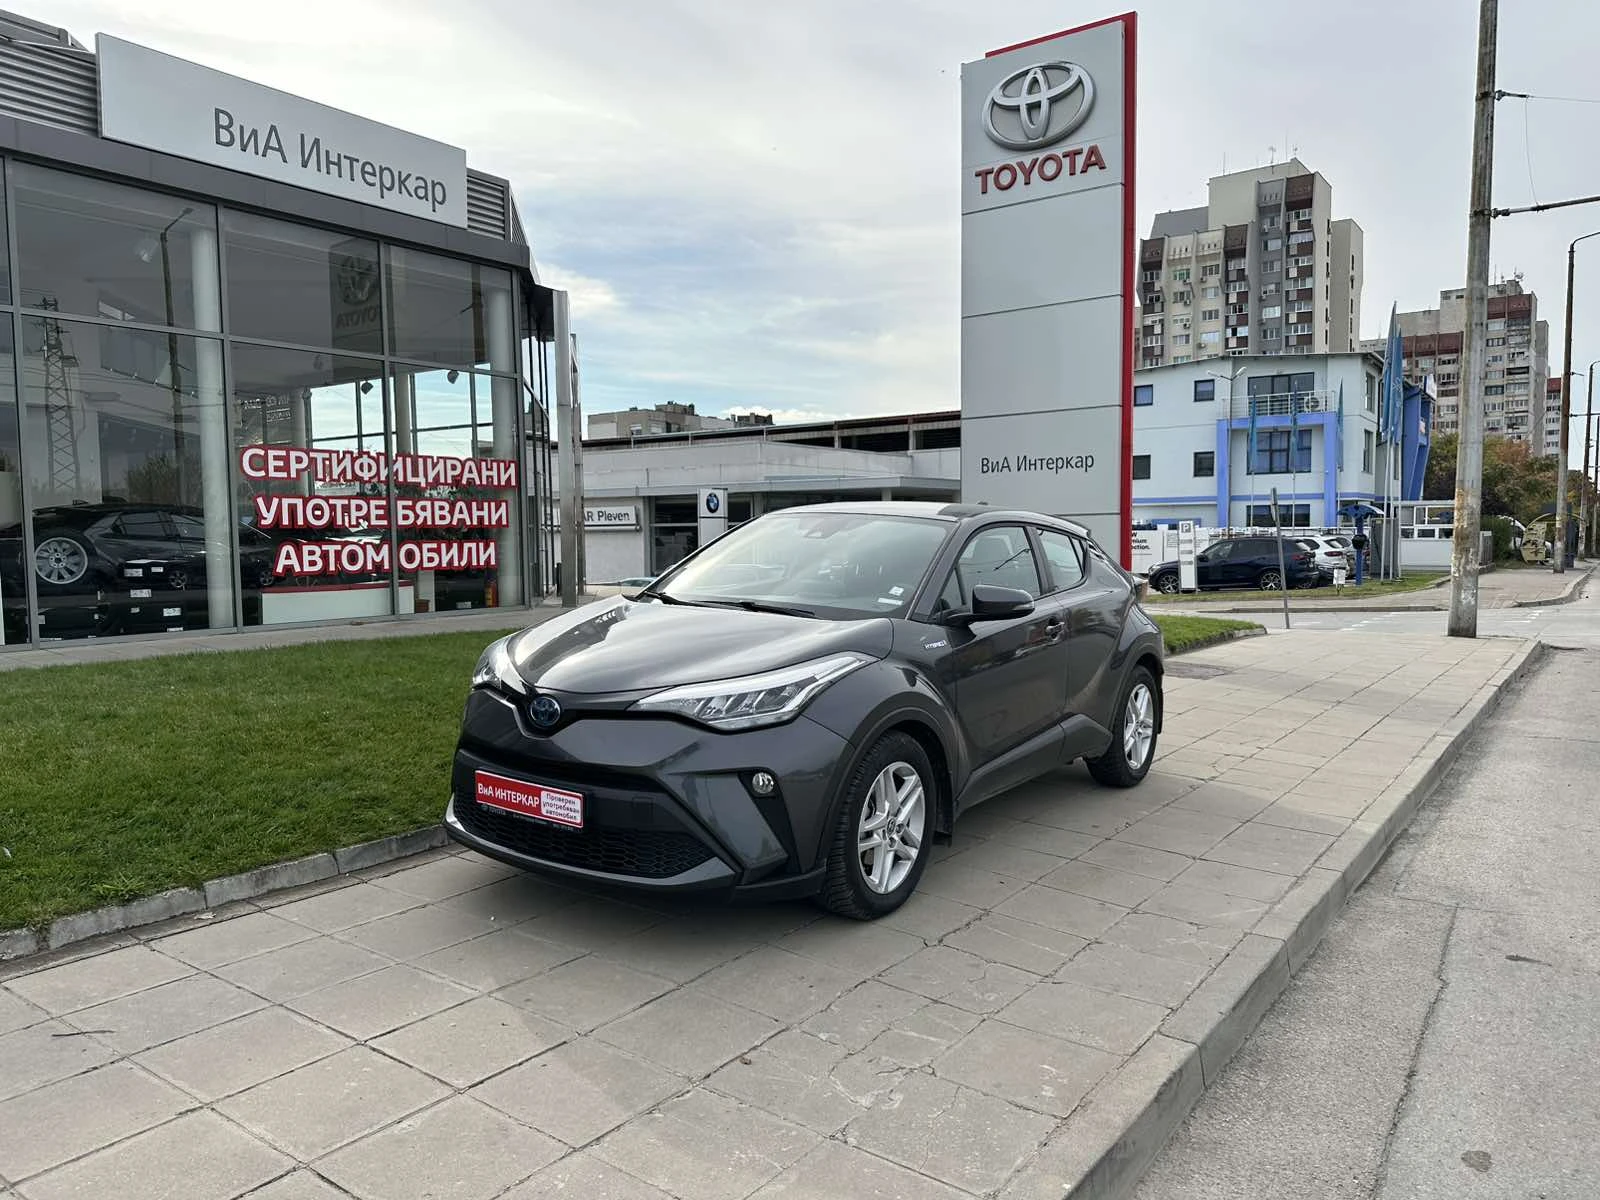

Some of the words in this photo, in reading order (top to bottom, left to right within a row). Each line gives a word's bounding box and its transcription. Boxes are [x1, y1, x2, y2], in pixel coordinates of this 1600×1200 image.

[214, 107, 288, 164] ВиА
[300, 133, 447, 213] Интеркар
[975, 144, 1107, 194] TOYOTA
[241, 447, 517, 487] СЕРТИФИЦИРАНИ
[981, 456, 1012, 474] ВиА
[1017, 454, 1095, 475] Интеркар
[597, 510, 630, 521] Pleven
[477, 783, 494, 797] ВиА
[495, 787, 540, 808] ИНТЕРКАР
